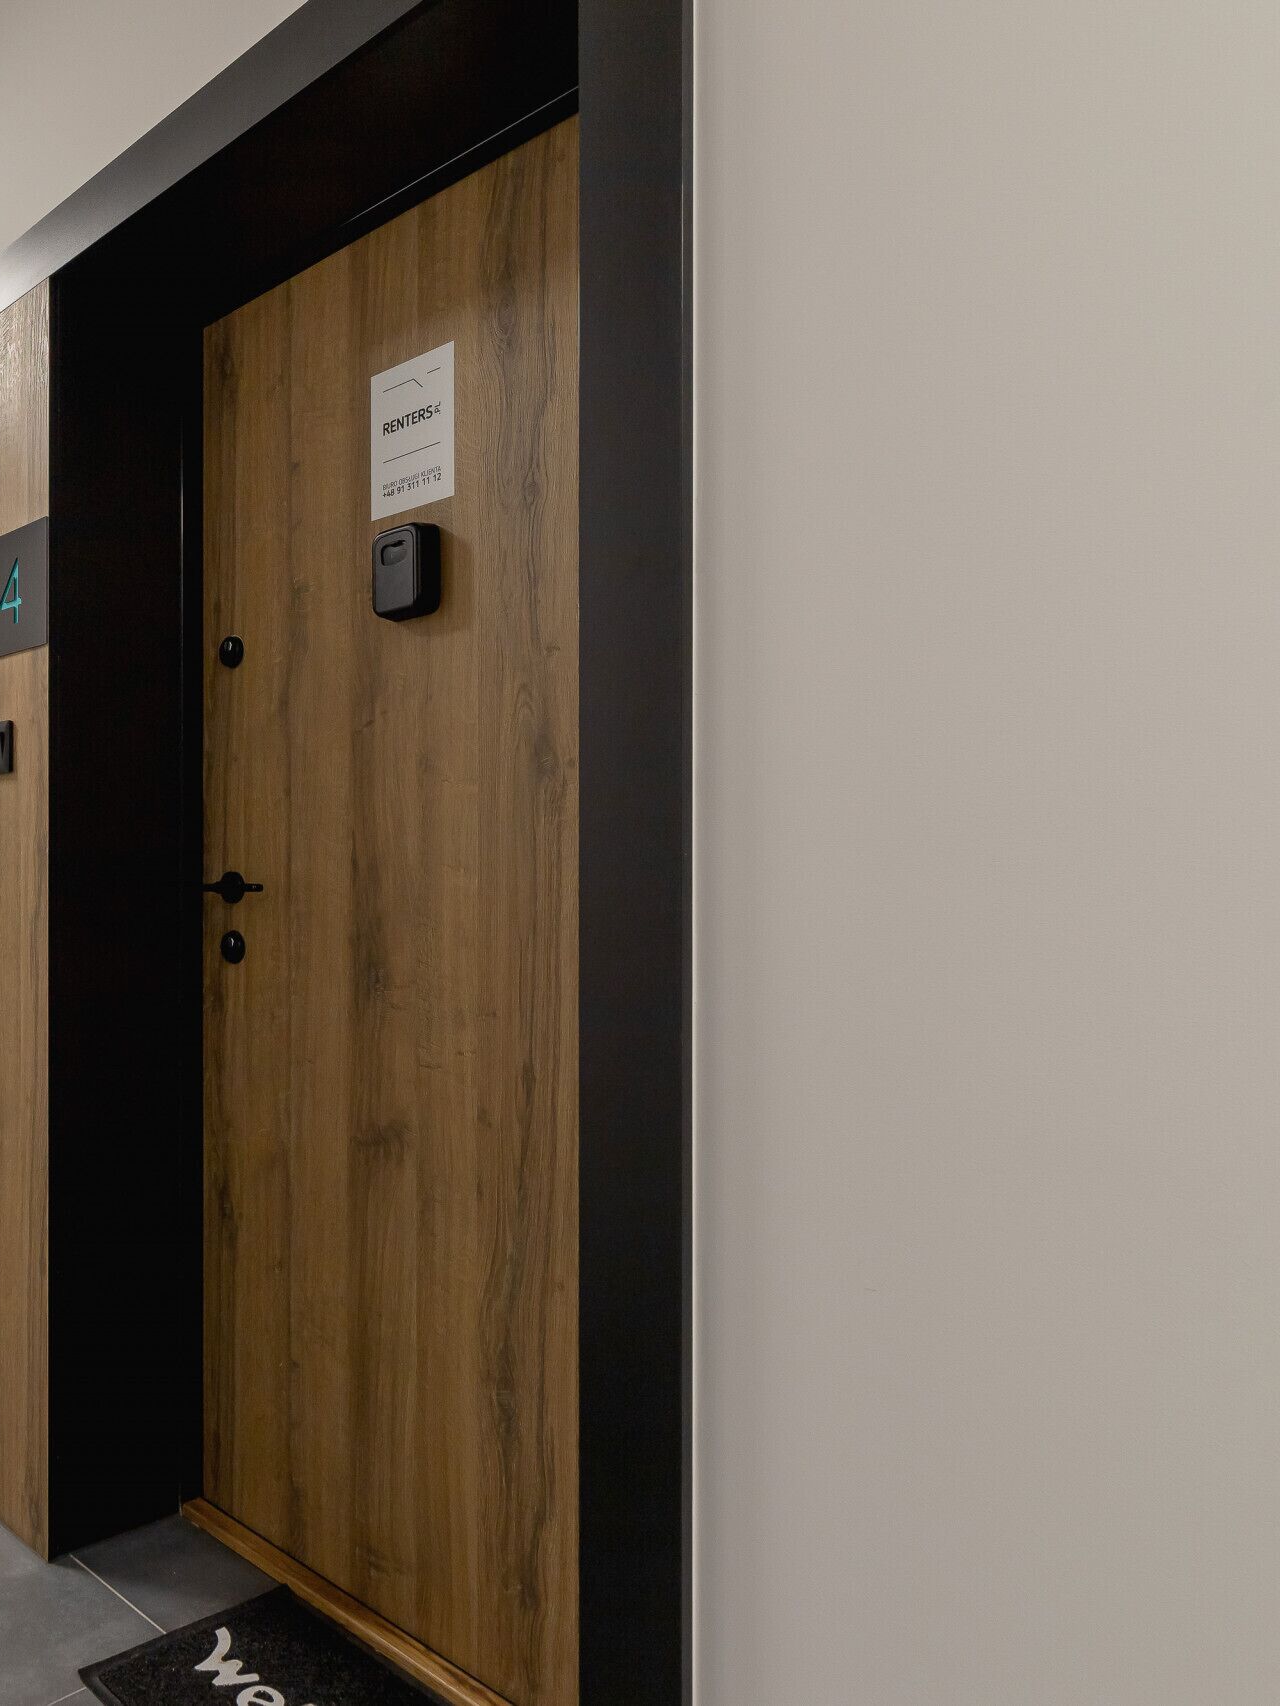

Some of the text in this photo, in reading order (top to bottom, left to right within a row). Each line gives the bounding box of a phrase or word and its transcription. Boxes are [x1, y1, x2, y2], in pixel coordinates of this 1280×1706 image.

[383, 405, 432, 436] RENTERS
[383, 481, 397, 490] BIURO
[421, 466, 441, 477] KLIENTA
[383, 473, 441, 497] +48 91 311 11 12
